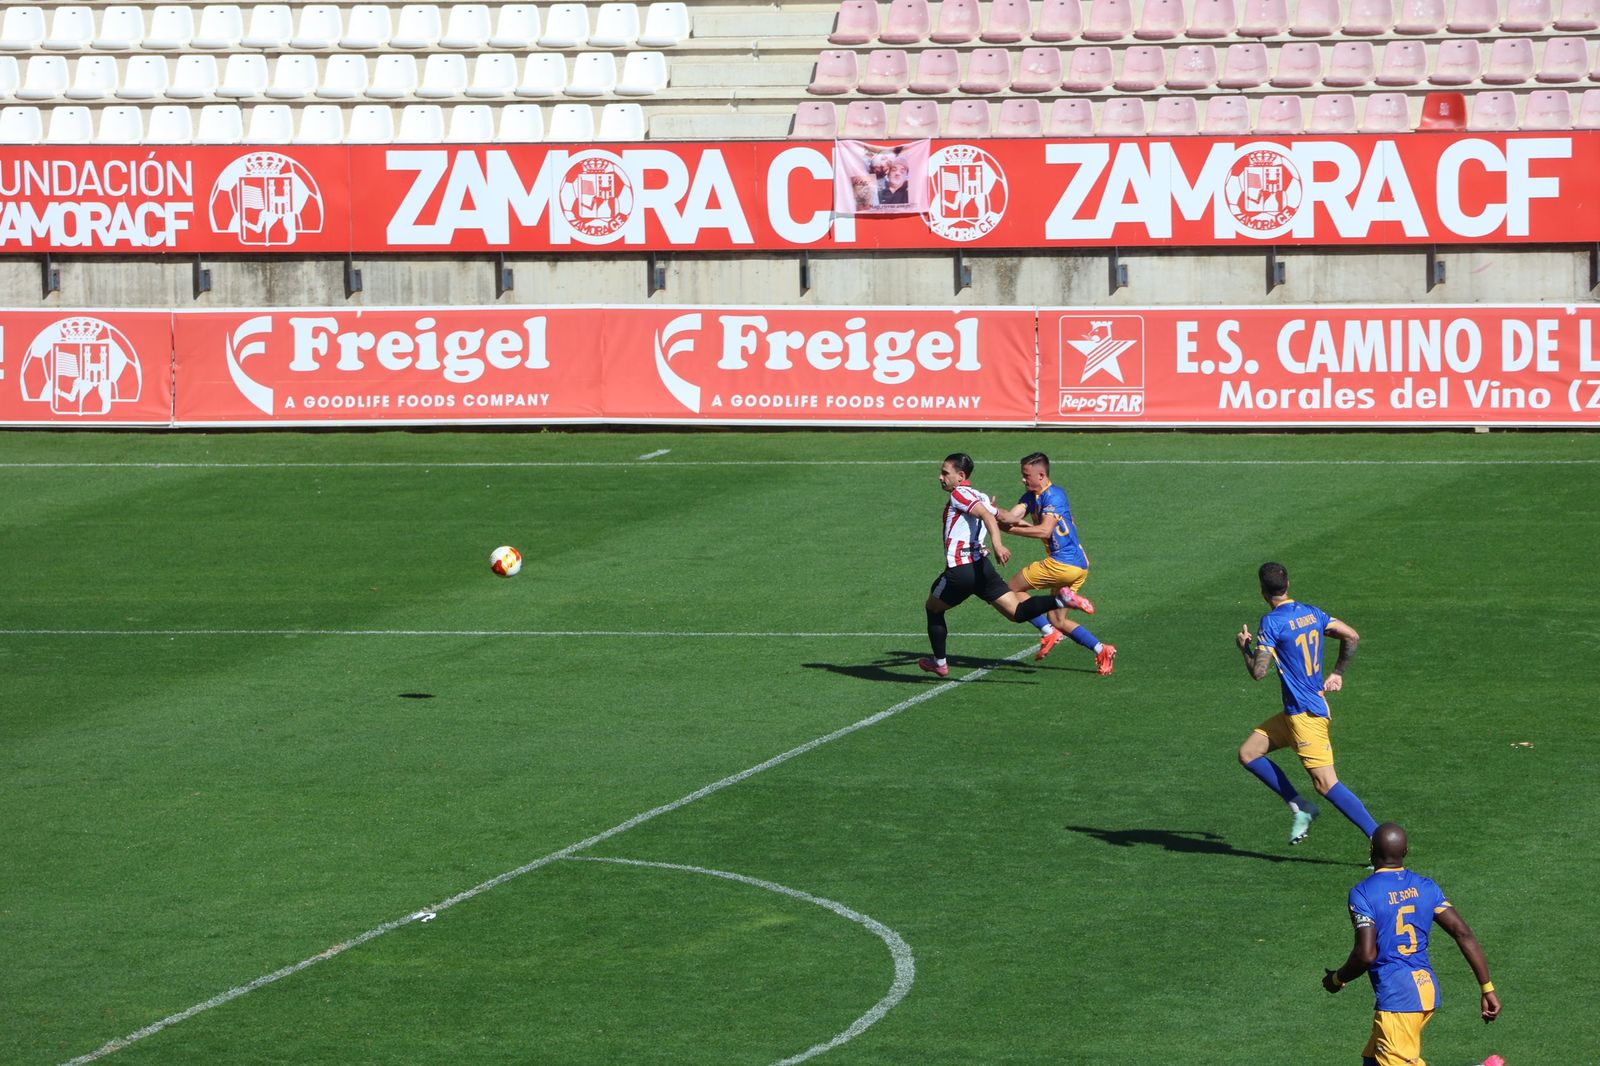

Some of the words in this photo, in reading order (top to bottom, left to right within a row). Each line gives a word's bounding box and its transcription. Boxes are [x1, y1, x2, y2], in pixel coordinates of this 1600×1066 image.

[0, 151, 193, 197] UNDACIÓN
[385, 148, 755, 246] ZAMORA
[1045, 140, 1430, 240] ZAMORA
[1436, 137, 1573, 238] CF
[0, 201, 194, 246] AMORACF
[288, 316, 551, 384] Freigel
[716, 315, 982, 385] Freigel
[1176, 319, 1260, 375] E.S.
[1276, 317, 1483, 375] CAMINO
[1501, 318, 1560, 373] DE
[284, 395, 296, 409] A
[303, 394, 390, 409] GOODLIFE
[397, 394, 456, 408] FOODS
[462, 393, 550, 407] COMPANY
[711, 394, 723, 407] A
[730, 394, 818, 408] GOODLIFE
[825, 395, 885, 409] FOODS
[892, 395, 981, 409] COMPANY
[1061, 394, 1142, 413] RepoSTAR
[1218, 377, 1376, 410] Morales
[1389, 376, 1449, 410] del
[1463, 379, 1552, 410] Vino
[1295, 629, 1320, 677] 12
[1395, 905, 1418, 956] 5
